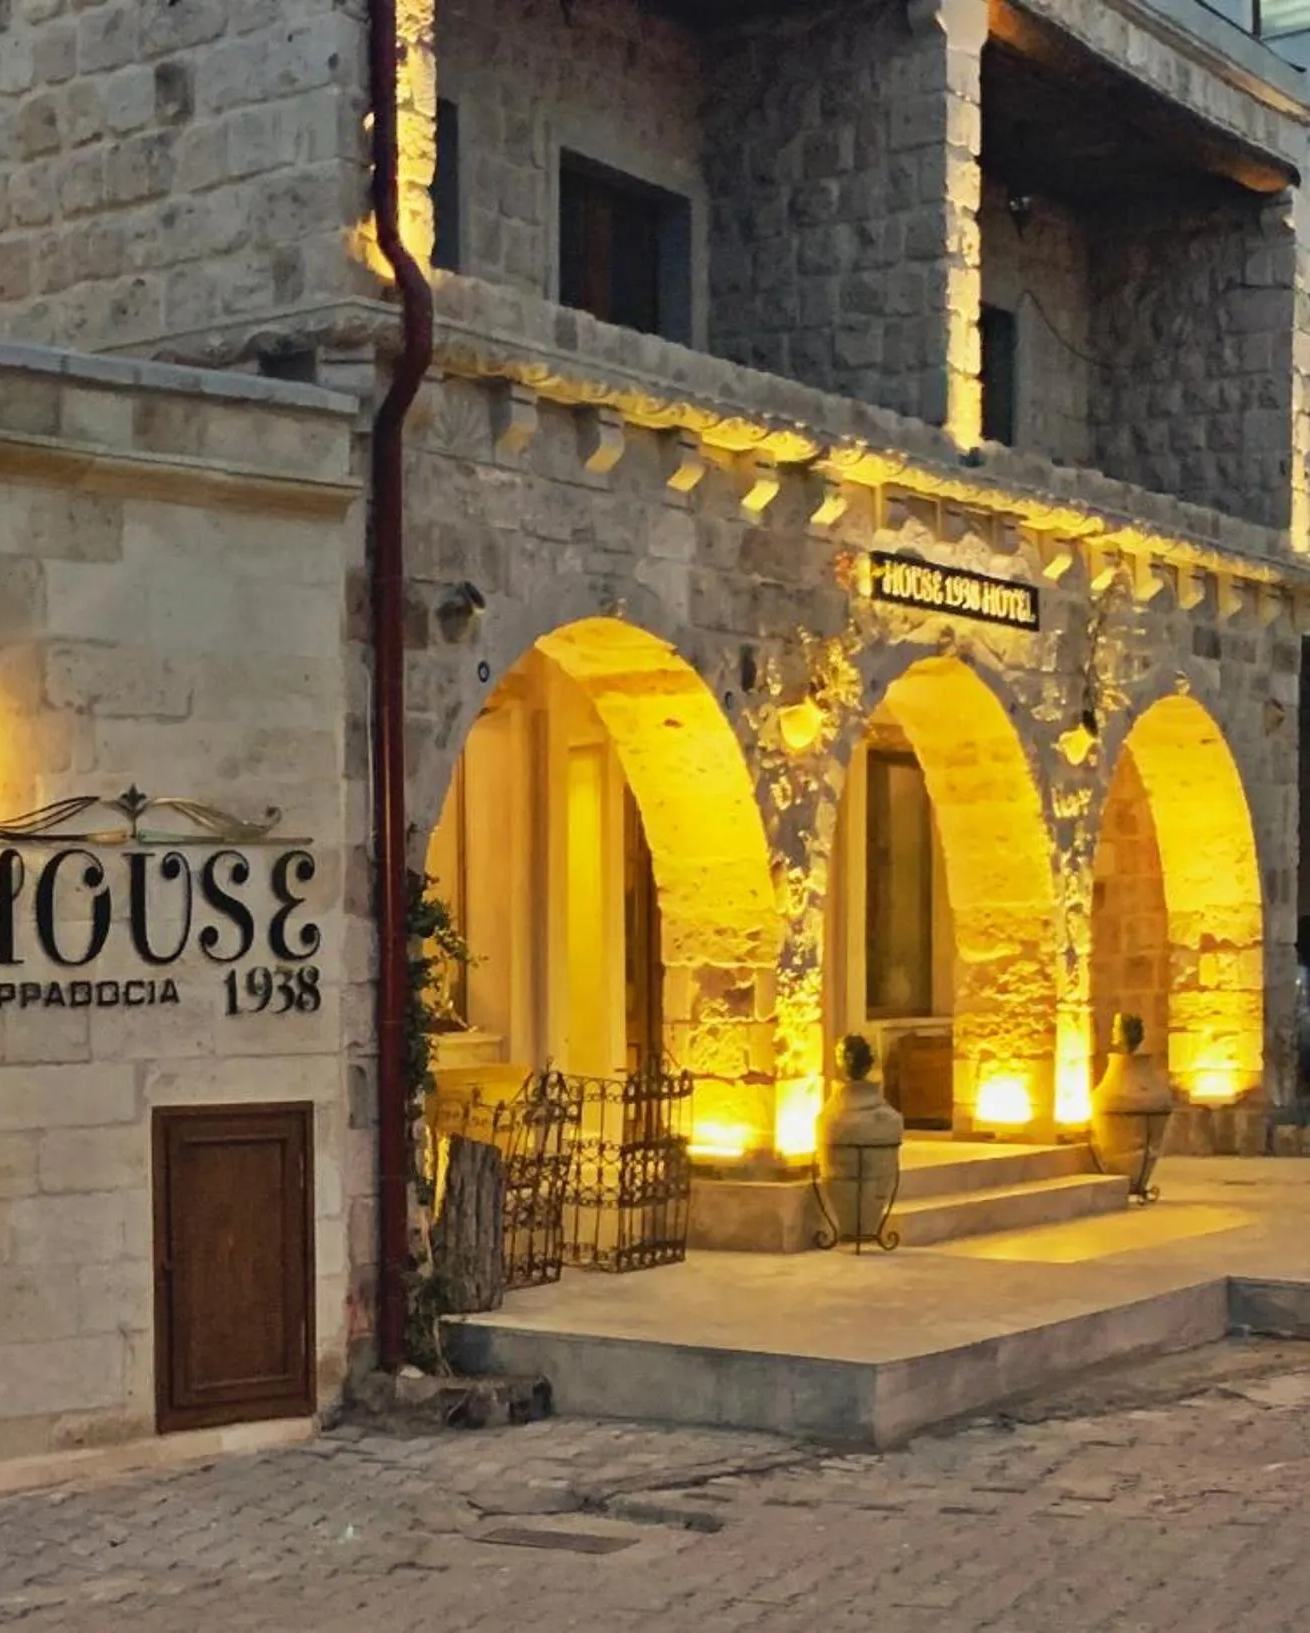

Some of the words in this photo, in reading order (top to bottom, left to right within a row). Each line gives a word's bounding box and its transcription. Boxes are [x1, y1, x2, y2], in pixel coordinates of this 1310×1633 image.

[882, 560, 943, 605] HOUSE
[945, 575, 981, 611] 1938
[982, 581, 1035, 623] HOTEL
[223, 966, 321, 1016] 1938
